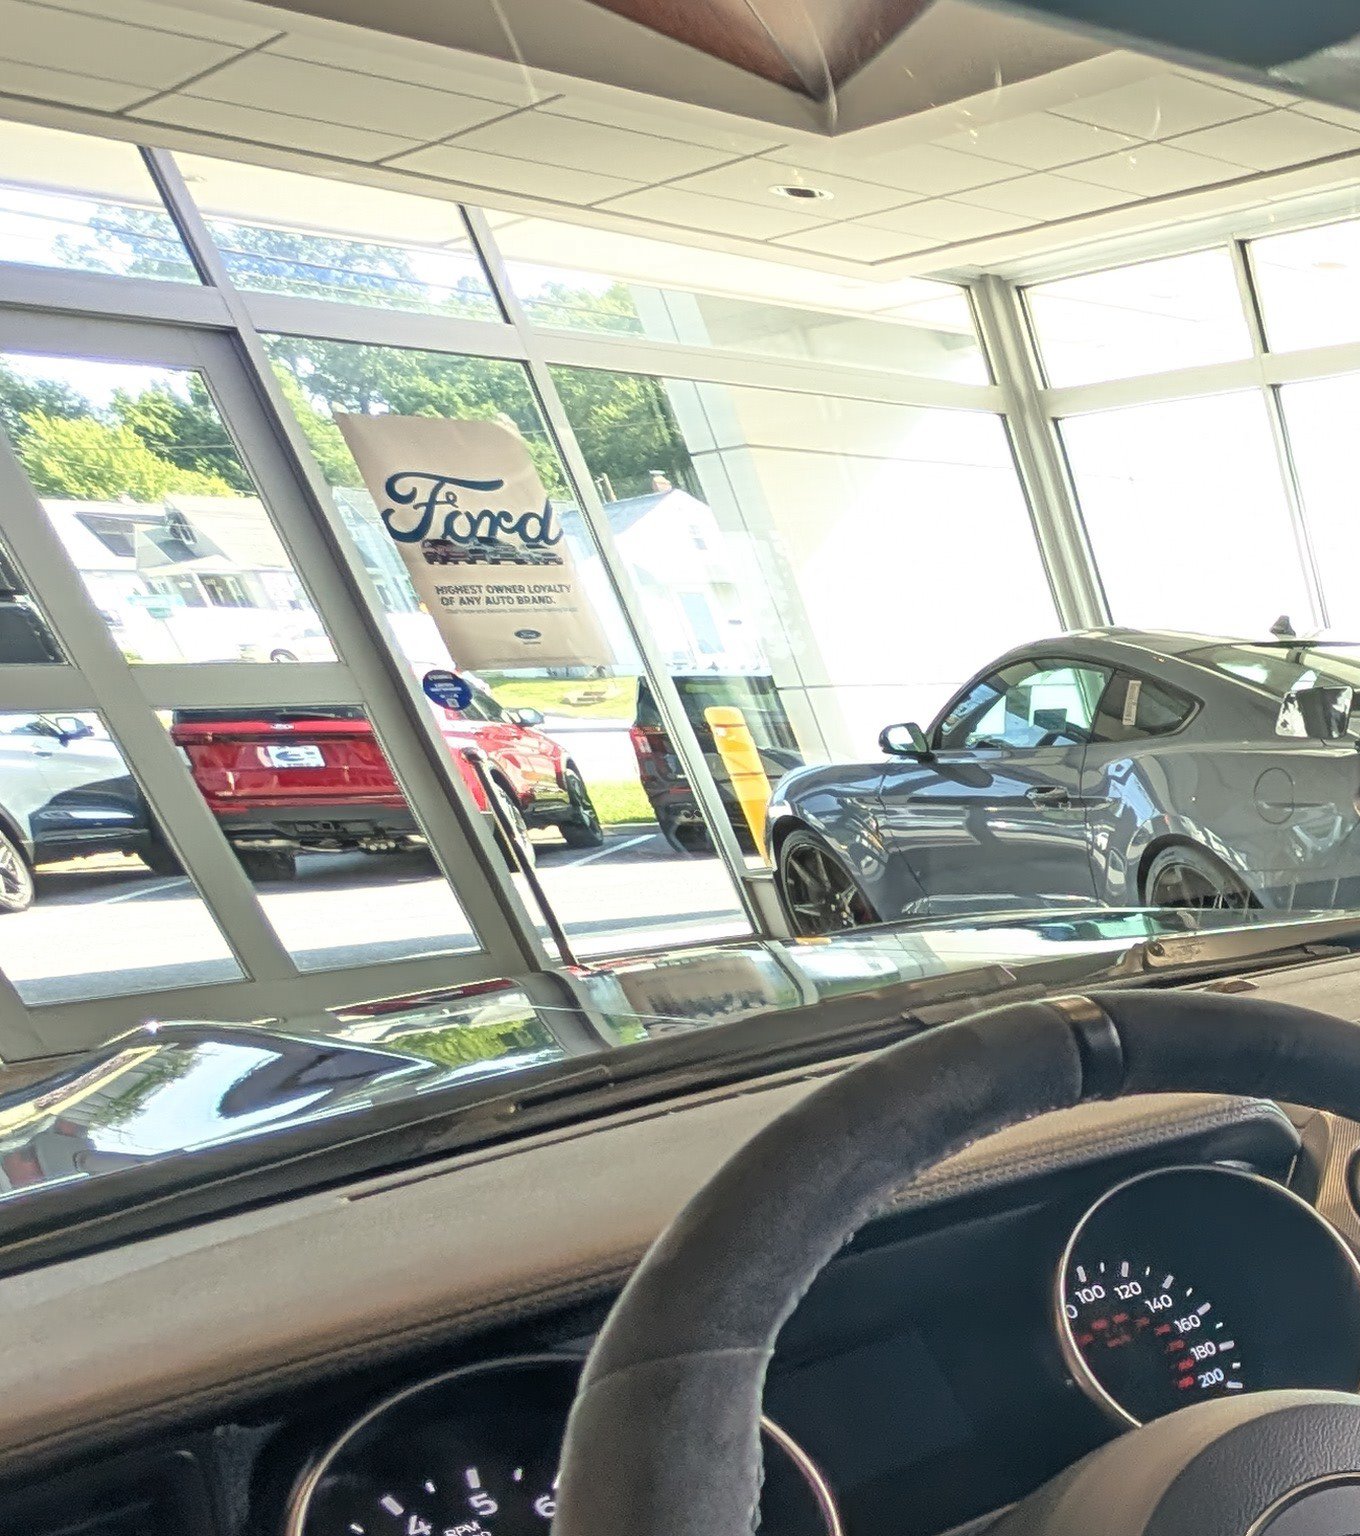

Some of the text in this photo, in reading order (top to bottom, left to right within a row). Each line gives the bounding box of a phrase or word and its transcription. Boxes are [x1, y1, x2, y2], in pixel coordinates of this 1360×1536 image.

[381, 471, 564, 546] Ford
[434, 584, 572, 596] HIGHEST OWNER LOYALTY
[440, 596, 455, 607] OF
[459, 596, 481, 606] ANY
[485, 596, 515, 606] AUTO
[1075, 1284, 1106, 1304] 100
[1114, 1281, 1142, 1300] 120
[1145, 1294, 1173, 1313] 140
[1174, 1314, 1201, 1333] 160
[1190, 1341, 1216, 1361] 180
[1198, 1368, 1225, 1388] 200
[469, 1492, 499, 1516] 5
[535, 1495, 557, 1517] 6
[408, 1514, 432, 1536] 4
